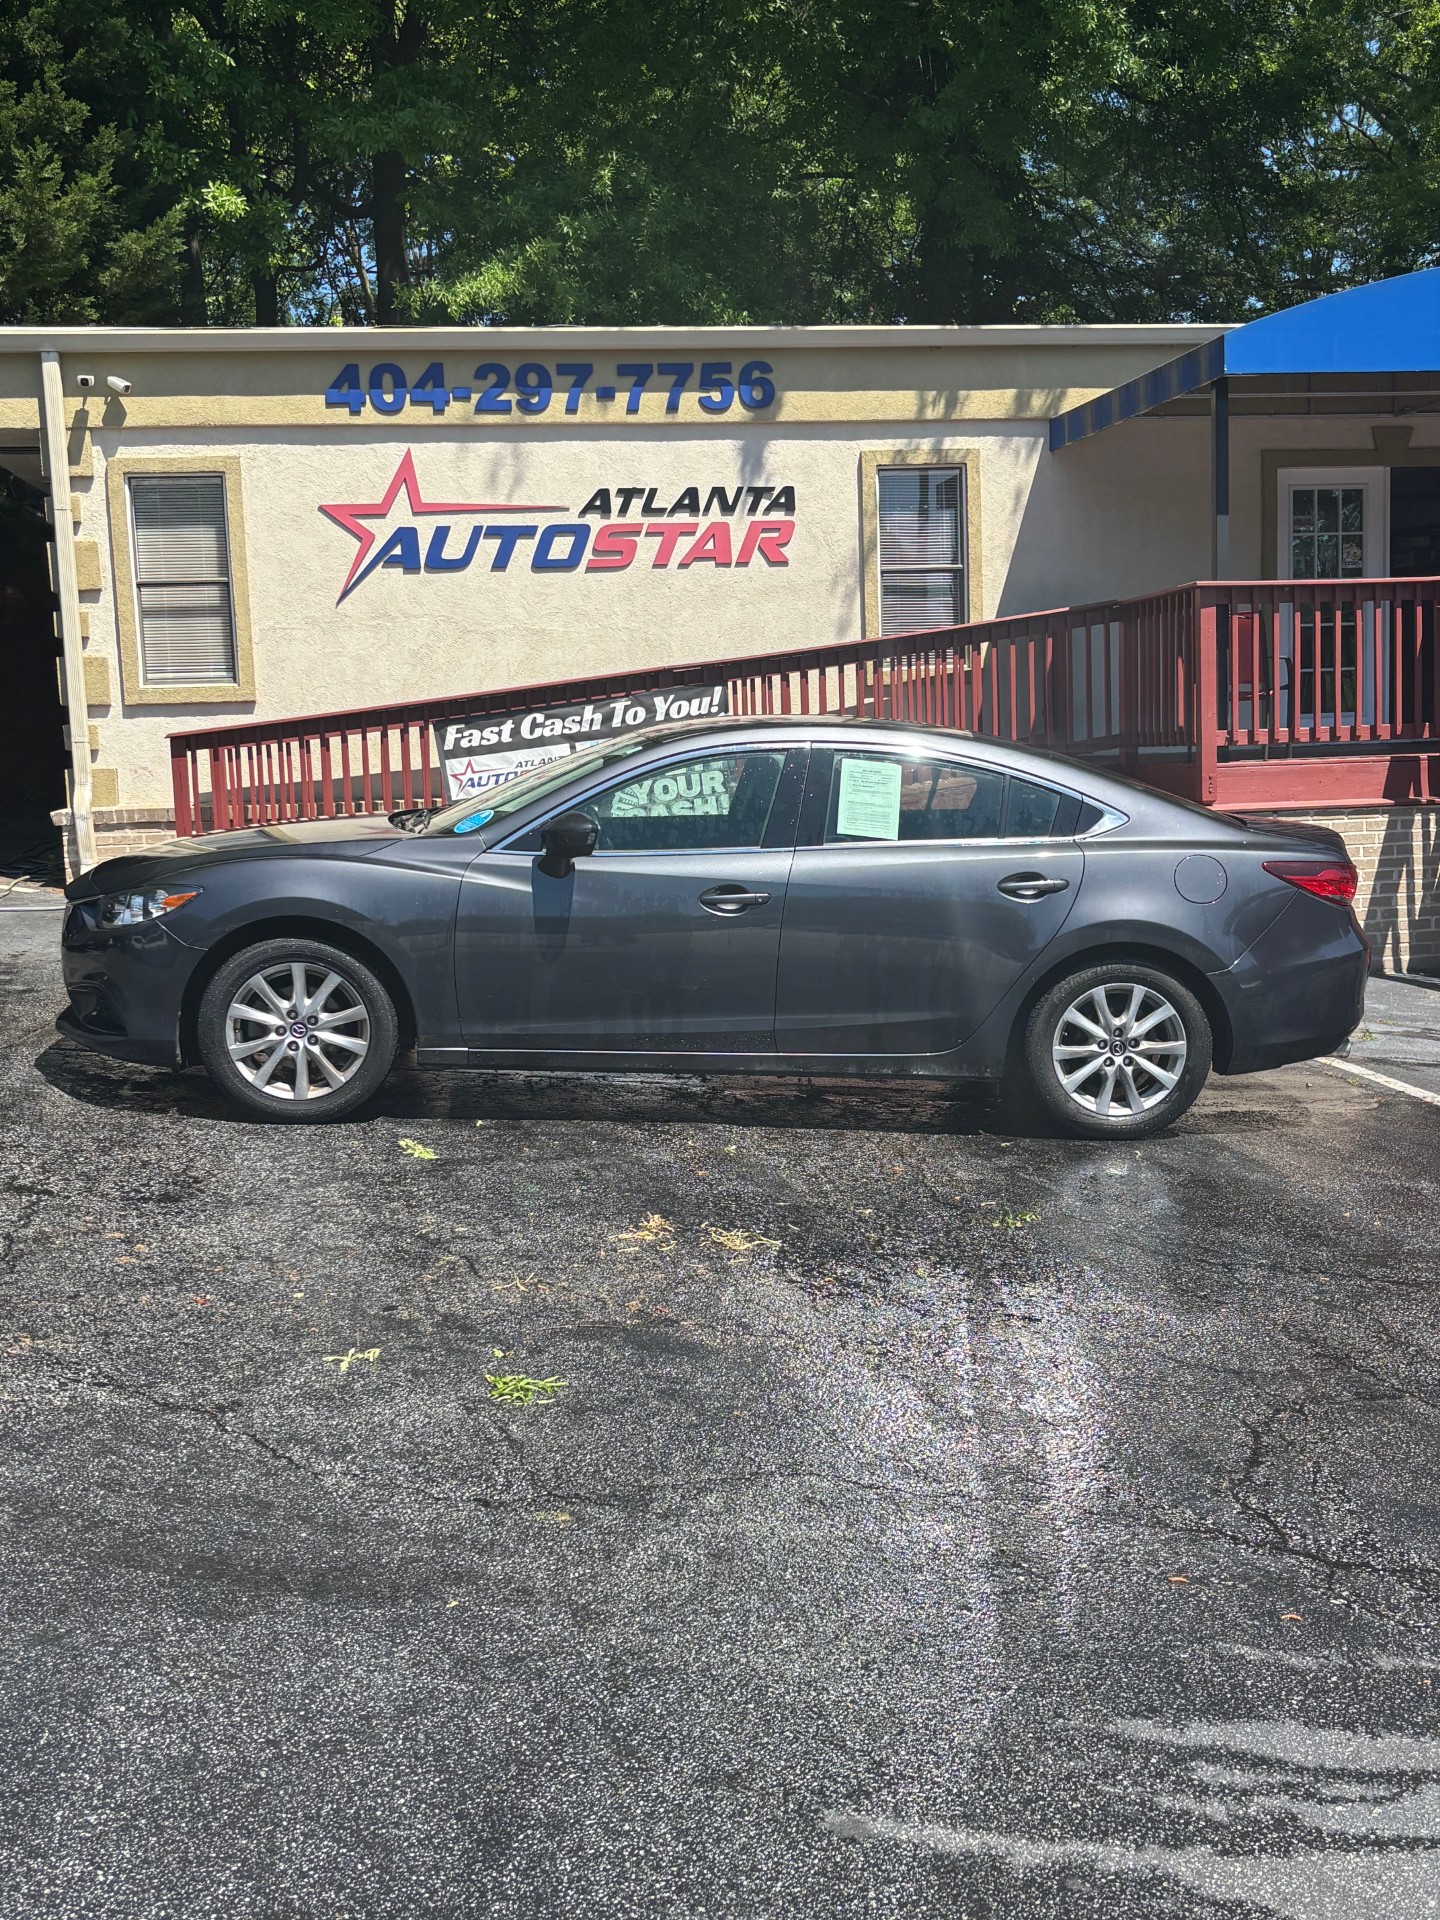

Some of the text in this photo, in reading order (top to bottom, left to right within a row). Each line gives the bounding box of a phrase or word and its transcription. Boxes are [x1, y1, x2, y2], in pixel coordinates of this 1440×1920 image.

[325, 361, 776, 416] 404-297-7756
[579, 485, 796, 517] ATLANTA
[382, 520, 796, 574] AUTOSTAR
[444, 686, 723, 750] Fast Cash To You!
[515, 755, 565, 769] ATLAN
[631, 771, 726, 805] YOUR
